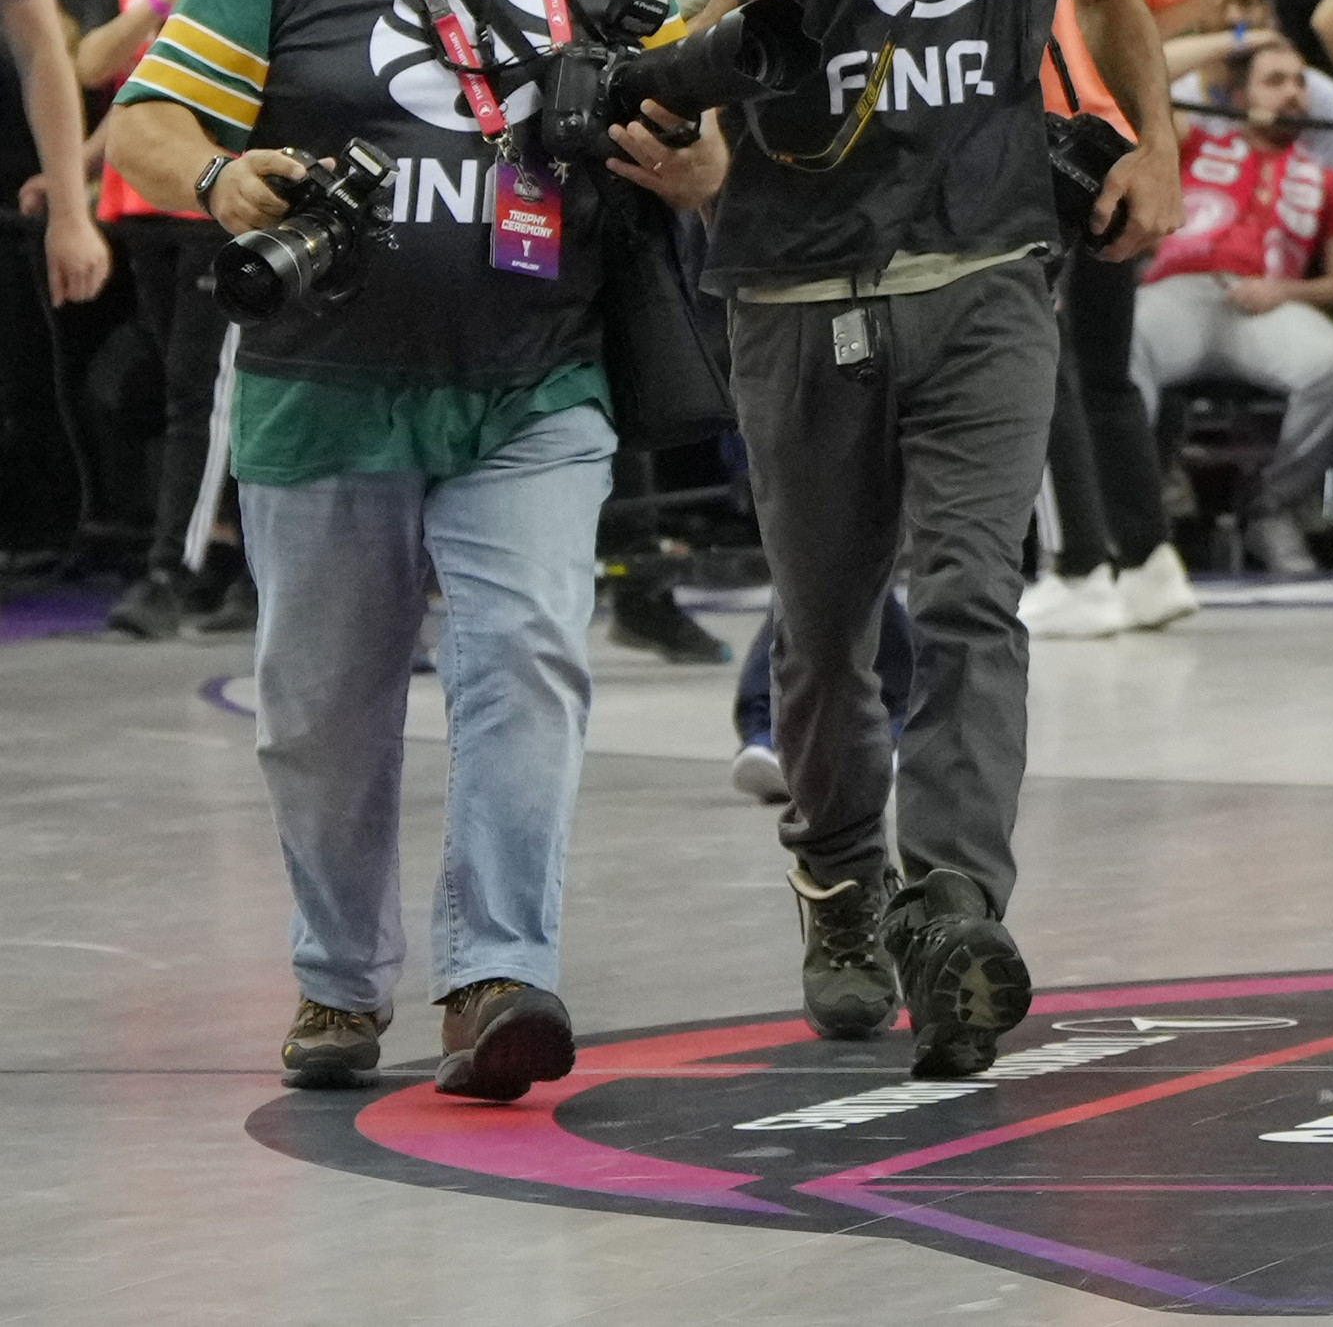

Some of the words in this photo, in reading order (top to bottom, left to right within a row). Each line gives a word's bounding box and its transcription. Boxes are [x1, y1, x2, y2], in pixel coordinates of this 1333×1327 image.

[335, 189, 359, 210] Nikon
[508, 209, 548, 225] TROPHY
[501, 219, 553, 238] CEREMONY
[732, 1081, 999, 1130] AIRLINES
